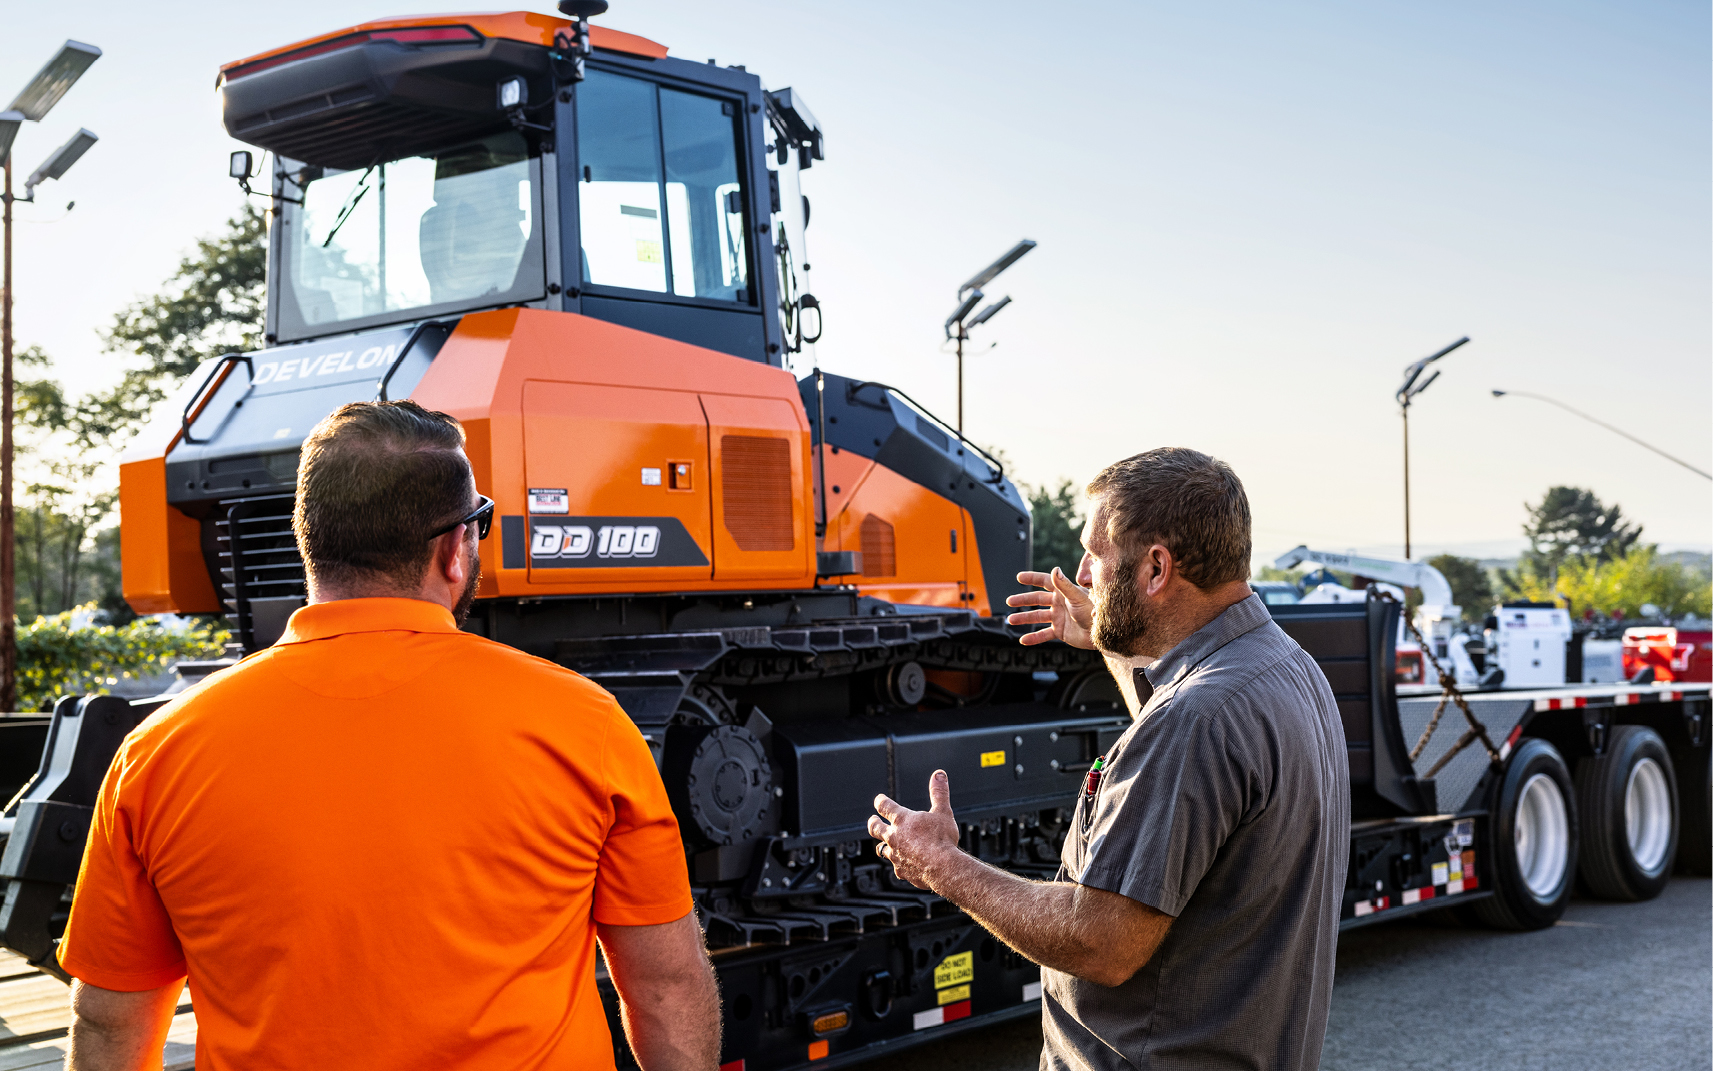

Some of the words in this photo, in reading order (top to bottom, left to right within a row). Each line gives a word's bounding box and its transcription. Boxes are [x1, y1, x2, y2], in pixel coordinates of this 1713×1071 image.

[252, 343, 404, 385] DEVELON
[530, 526, 594, 559] DD
[597, 526, 661, 558] 100
[953, 957, 967, 968] NOT
